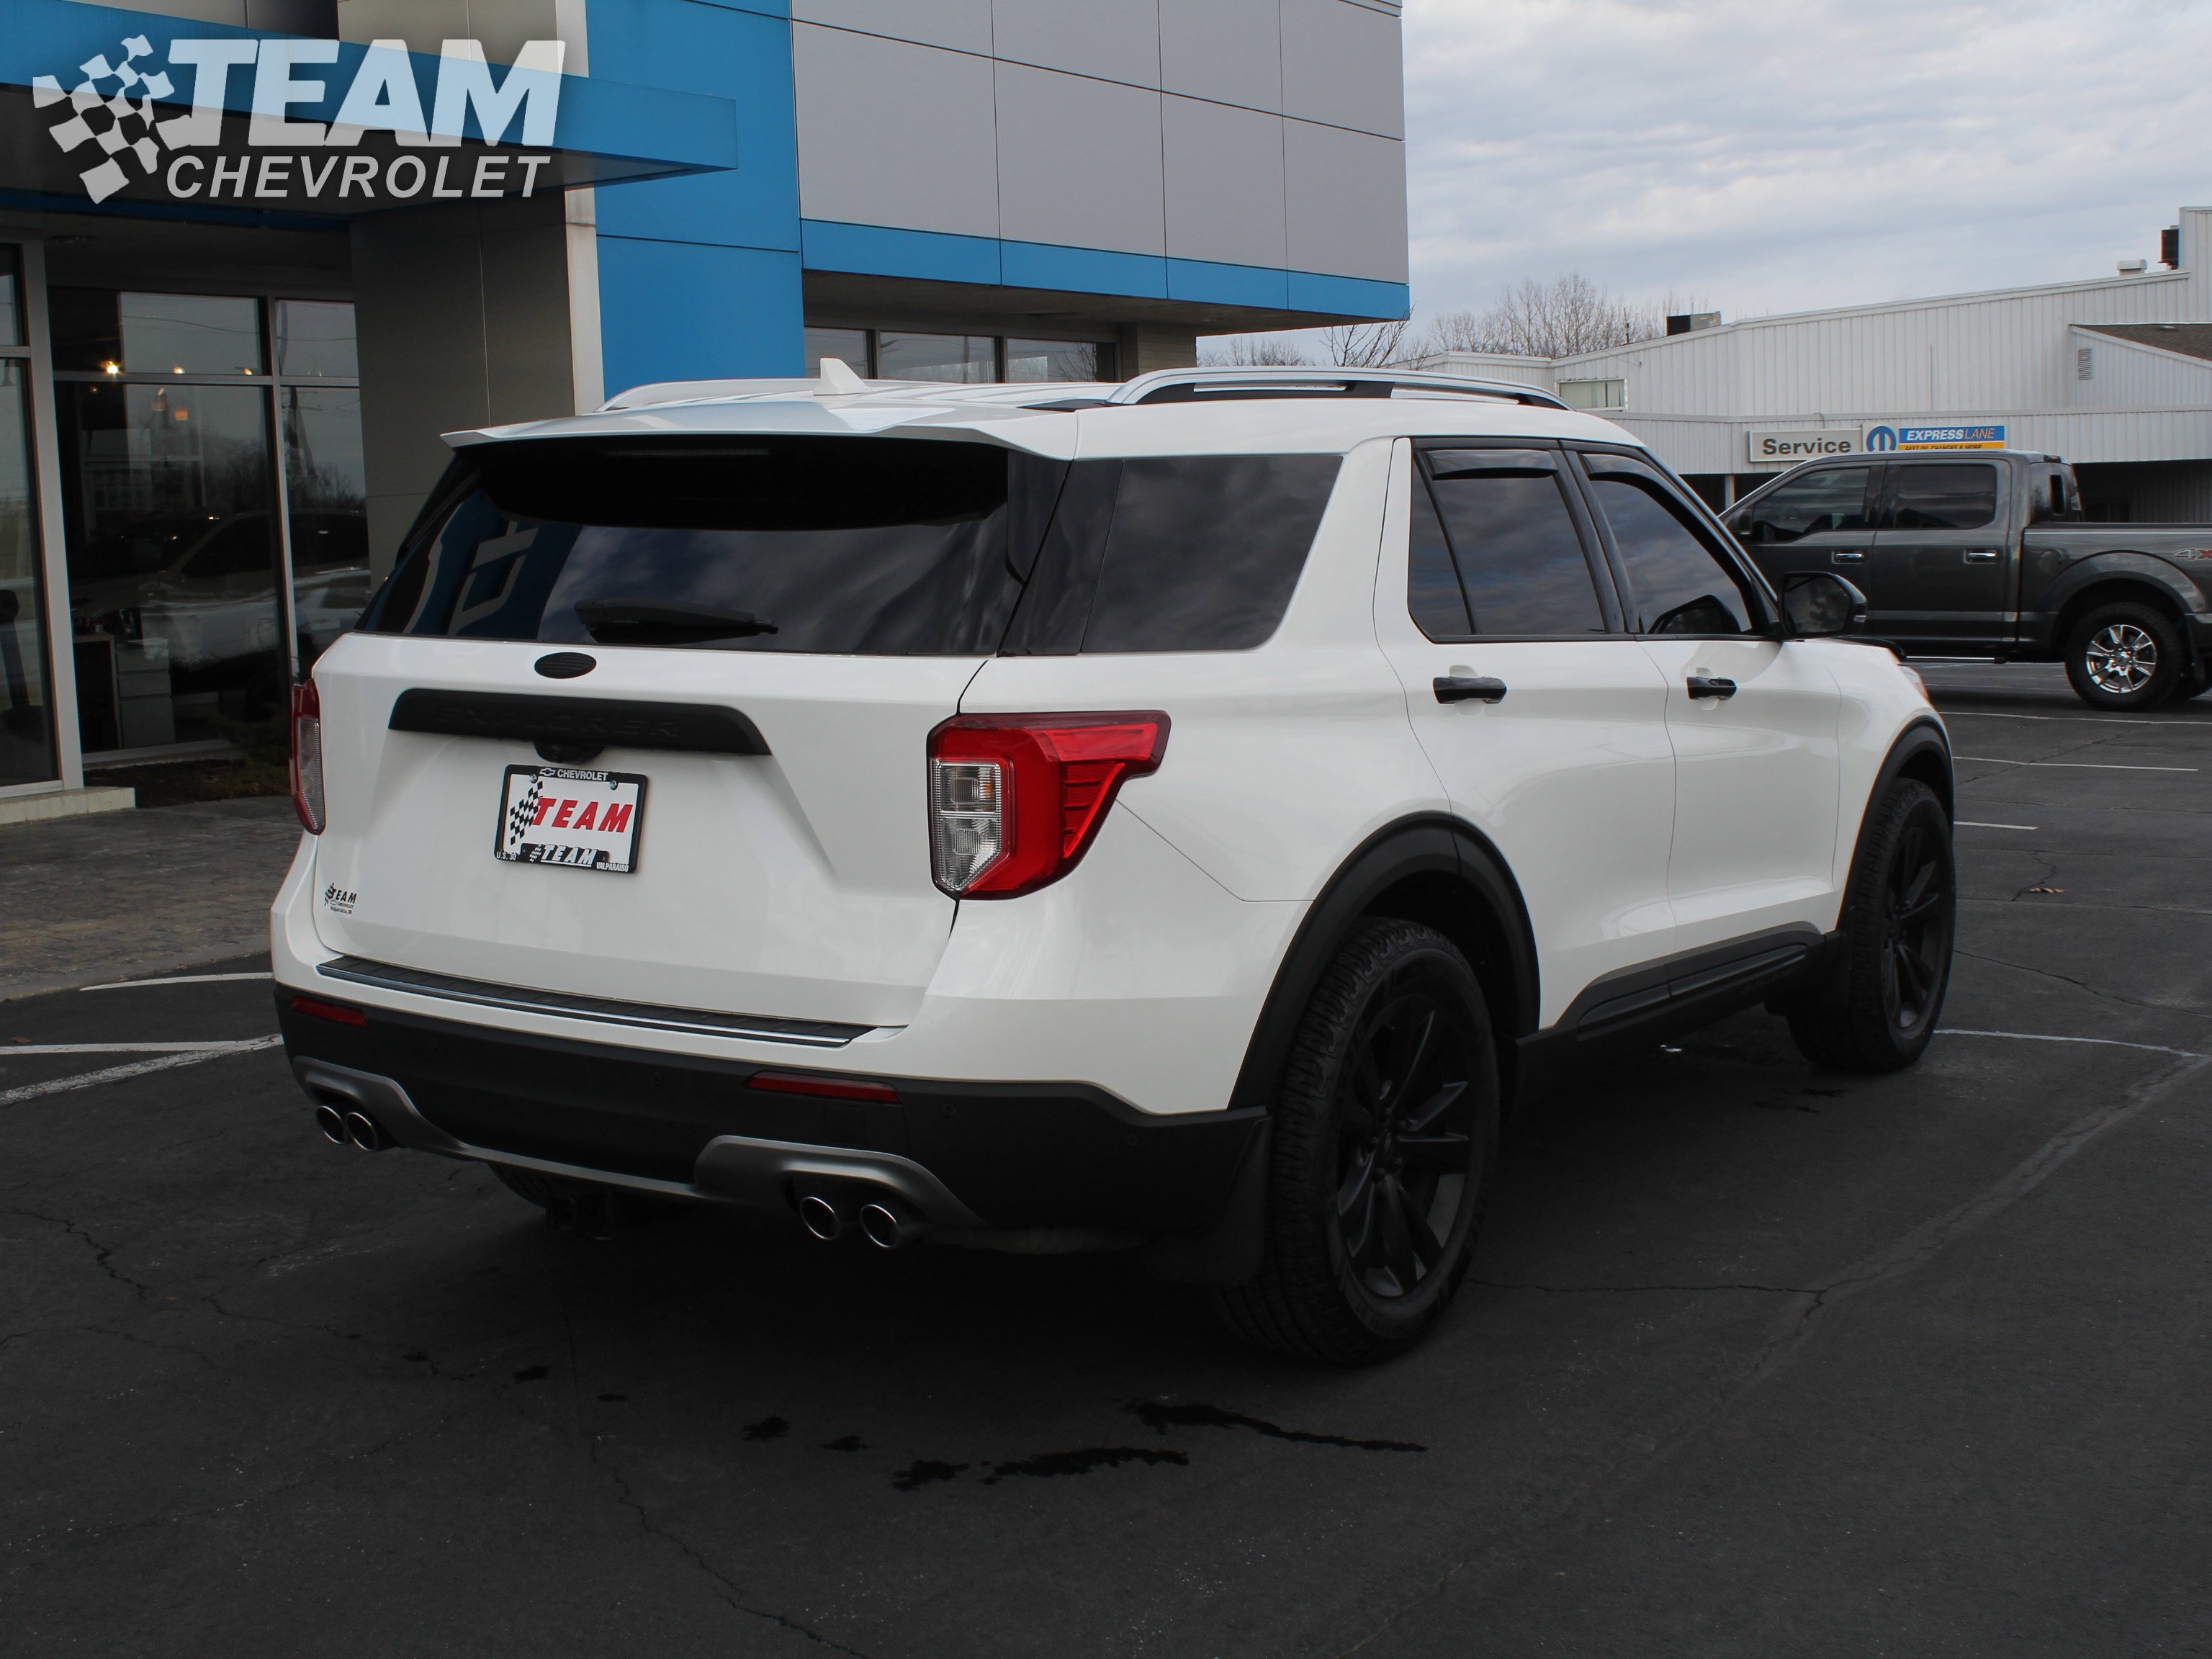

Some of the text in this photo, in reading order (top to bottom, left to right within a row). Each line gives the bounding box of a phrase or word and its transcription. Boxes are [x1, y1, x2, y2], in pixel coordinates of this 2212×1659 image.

[1763, 437, 1851, 455] Service
[557, 769, 608, 781] CHEVROLET
[533, 797, 633, 833] TEAM
[541, 845, 598, 865] TEAM
[596, 862, 629, 873] VALPARAISO
[331, 889, 357, 904] TEAM
